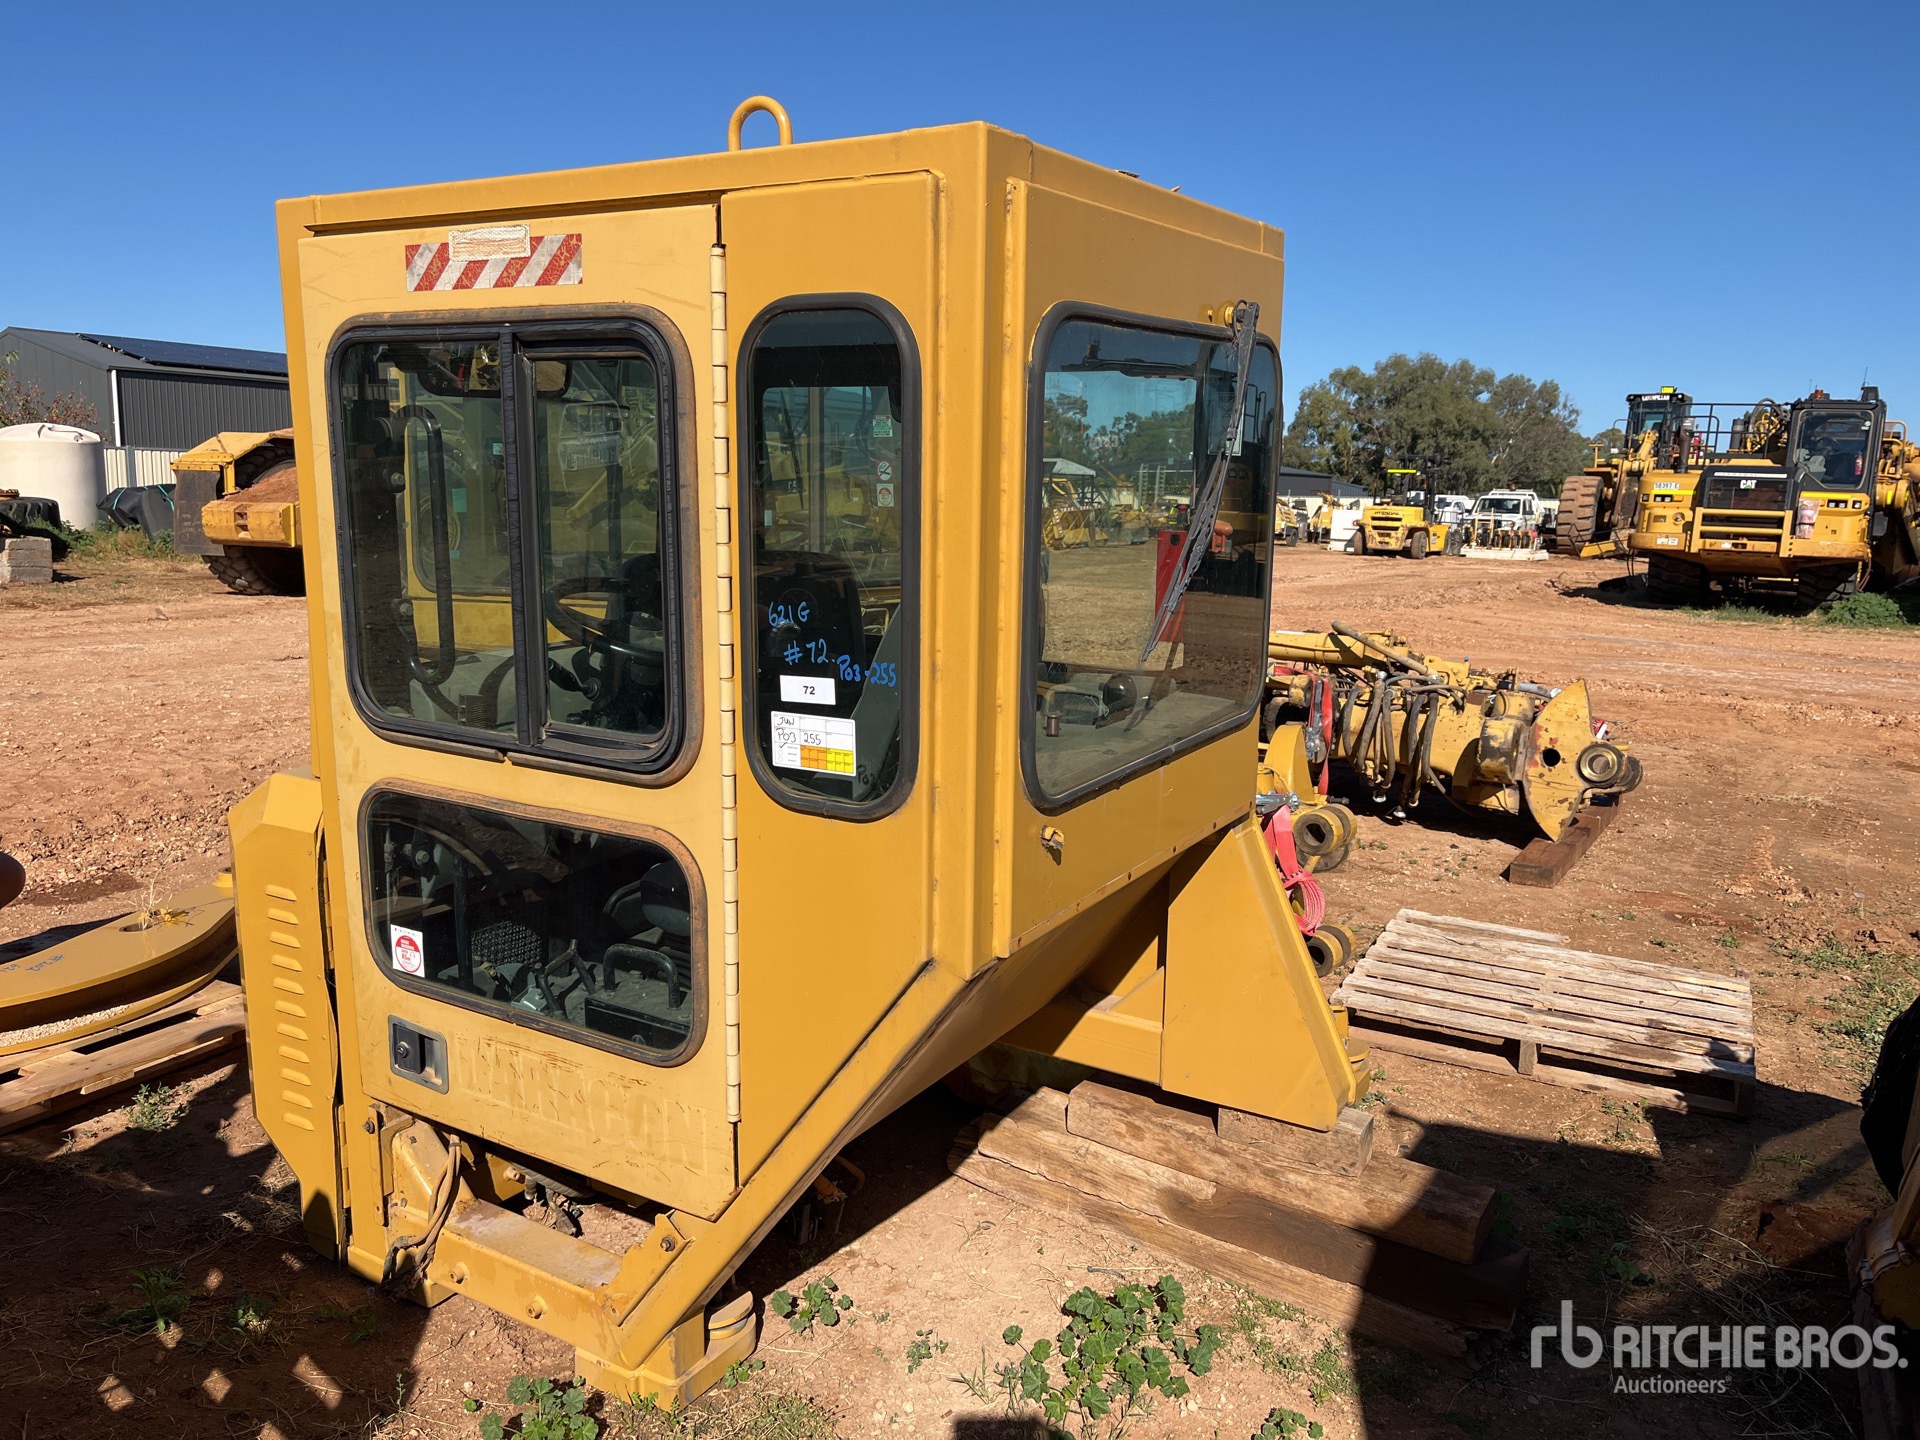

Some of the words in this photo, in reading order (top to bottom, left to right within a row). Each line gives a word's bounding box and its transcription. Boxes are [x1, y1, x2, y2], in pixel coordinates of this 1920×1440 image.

[1740, 479, 1757, 489] CAT
[768, 601, 811, 627] 621G
[803, 685, 816, 695] 72
[803, 732, 822, 746] 255
